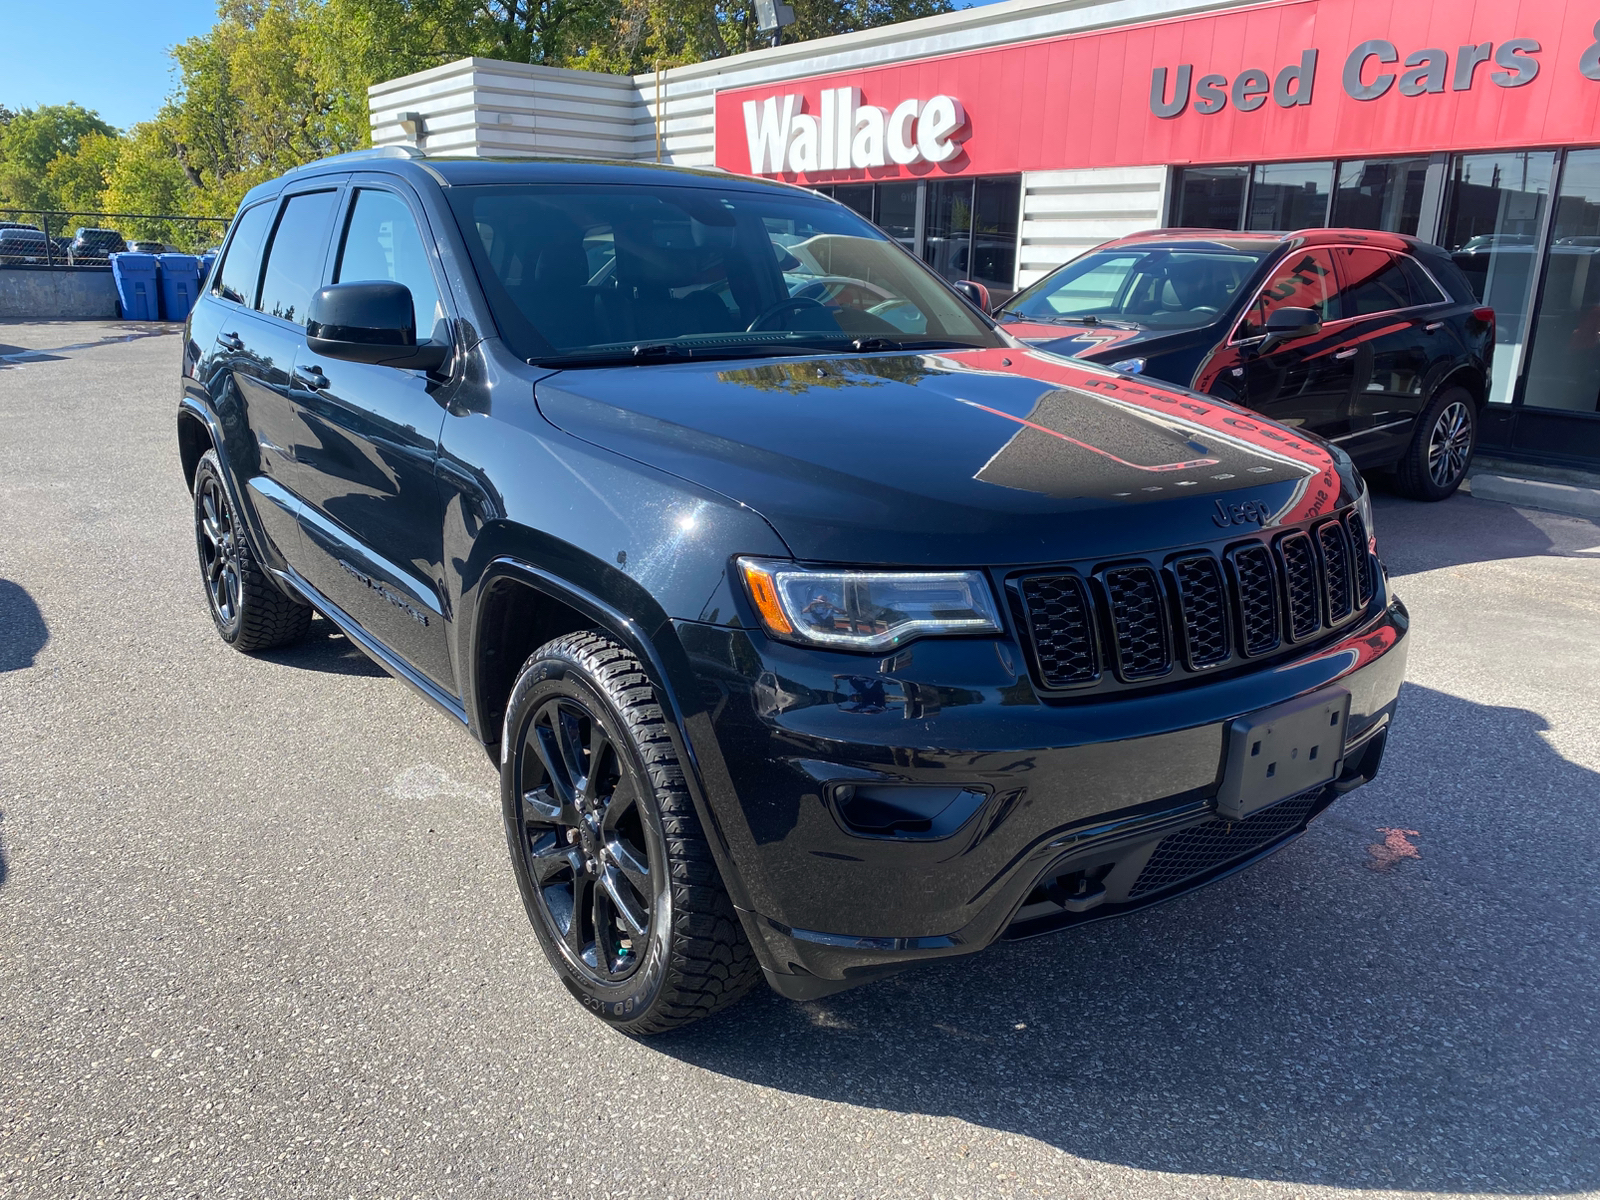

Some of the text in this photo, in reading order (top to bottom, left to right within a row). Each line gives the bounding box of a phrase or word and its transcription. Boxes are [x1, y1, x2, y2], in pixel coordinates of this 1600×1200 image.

[1150, 48, 1319, 119] Used
[1342, 37, 1542, 102] Cars
[743, 86, 965, 175] Wallace
[1212, 498, 1270, 528] Jeep
